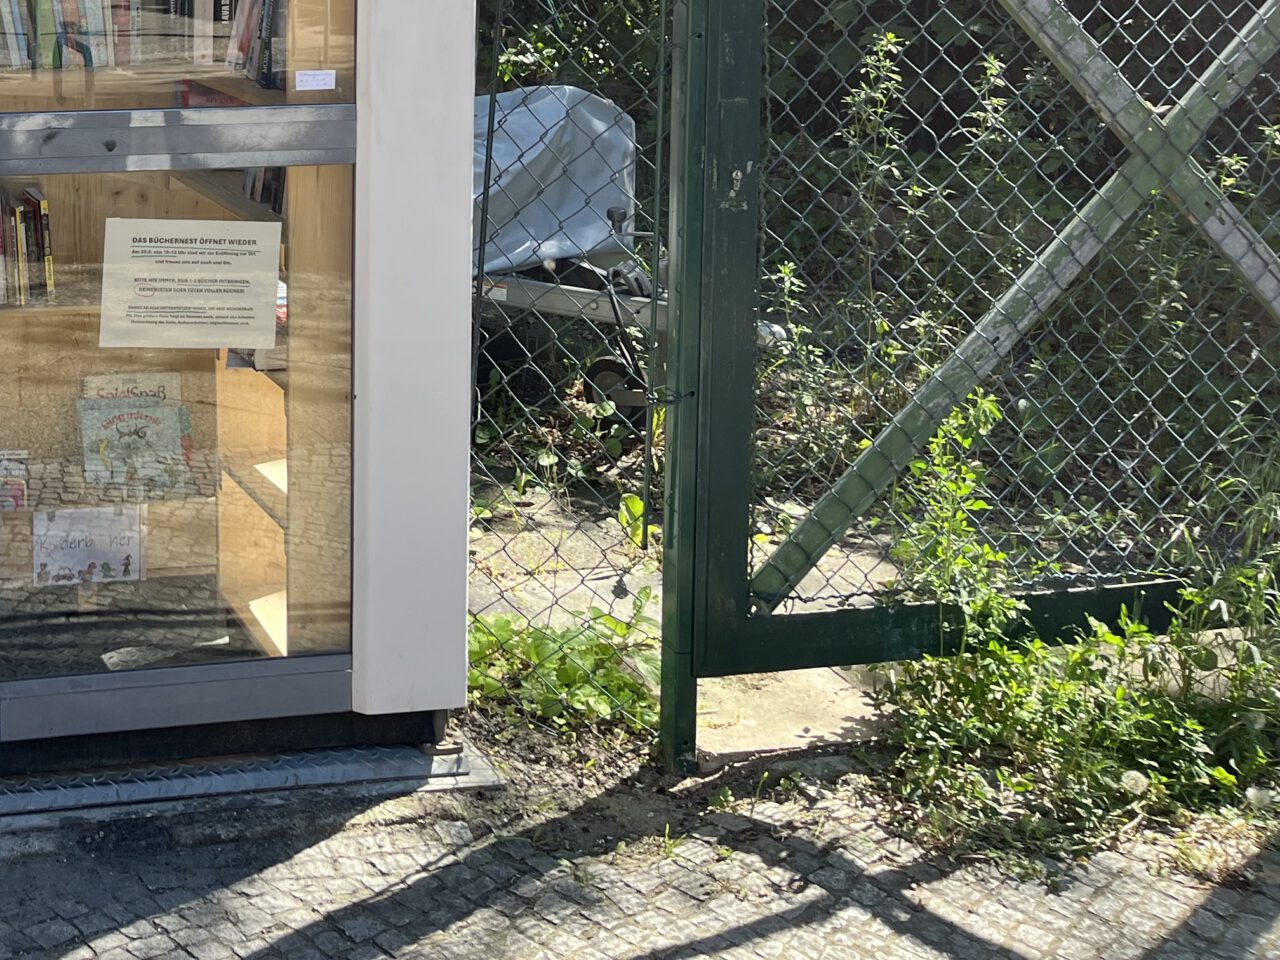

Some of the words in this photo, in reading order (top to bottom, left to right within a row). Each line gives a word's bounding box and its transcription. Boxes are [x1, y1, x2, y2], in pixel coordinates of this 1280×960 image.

[148, 236, 198, 245] BÜCHERNEST
[199, 237, 227, 245] ÖFFNET
[39, 534, 133, 552] Kderbher
